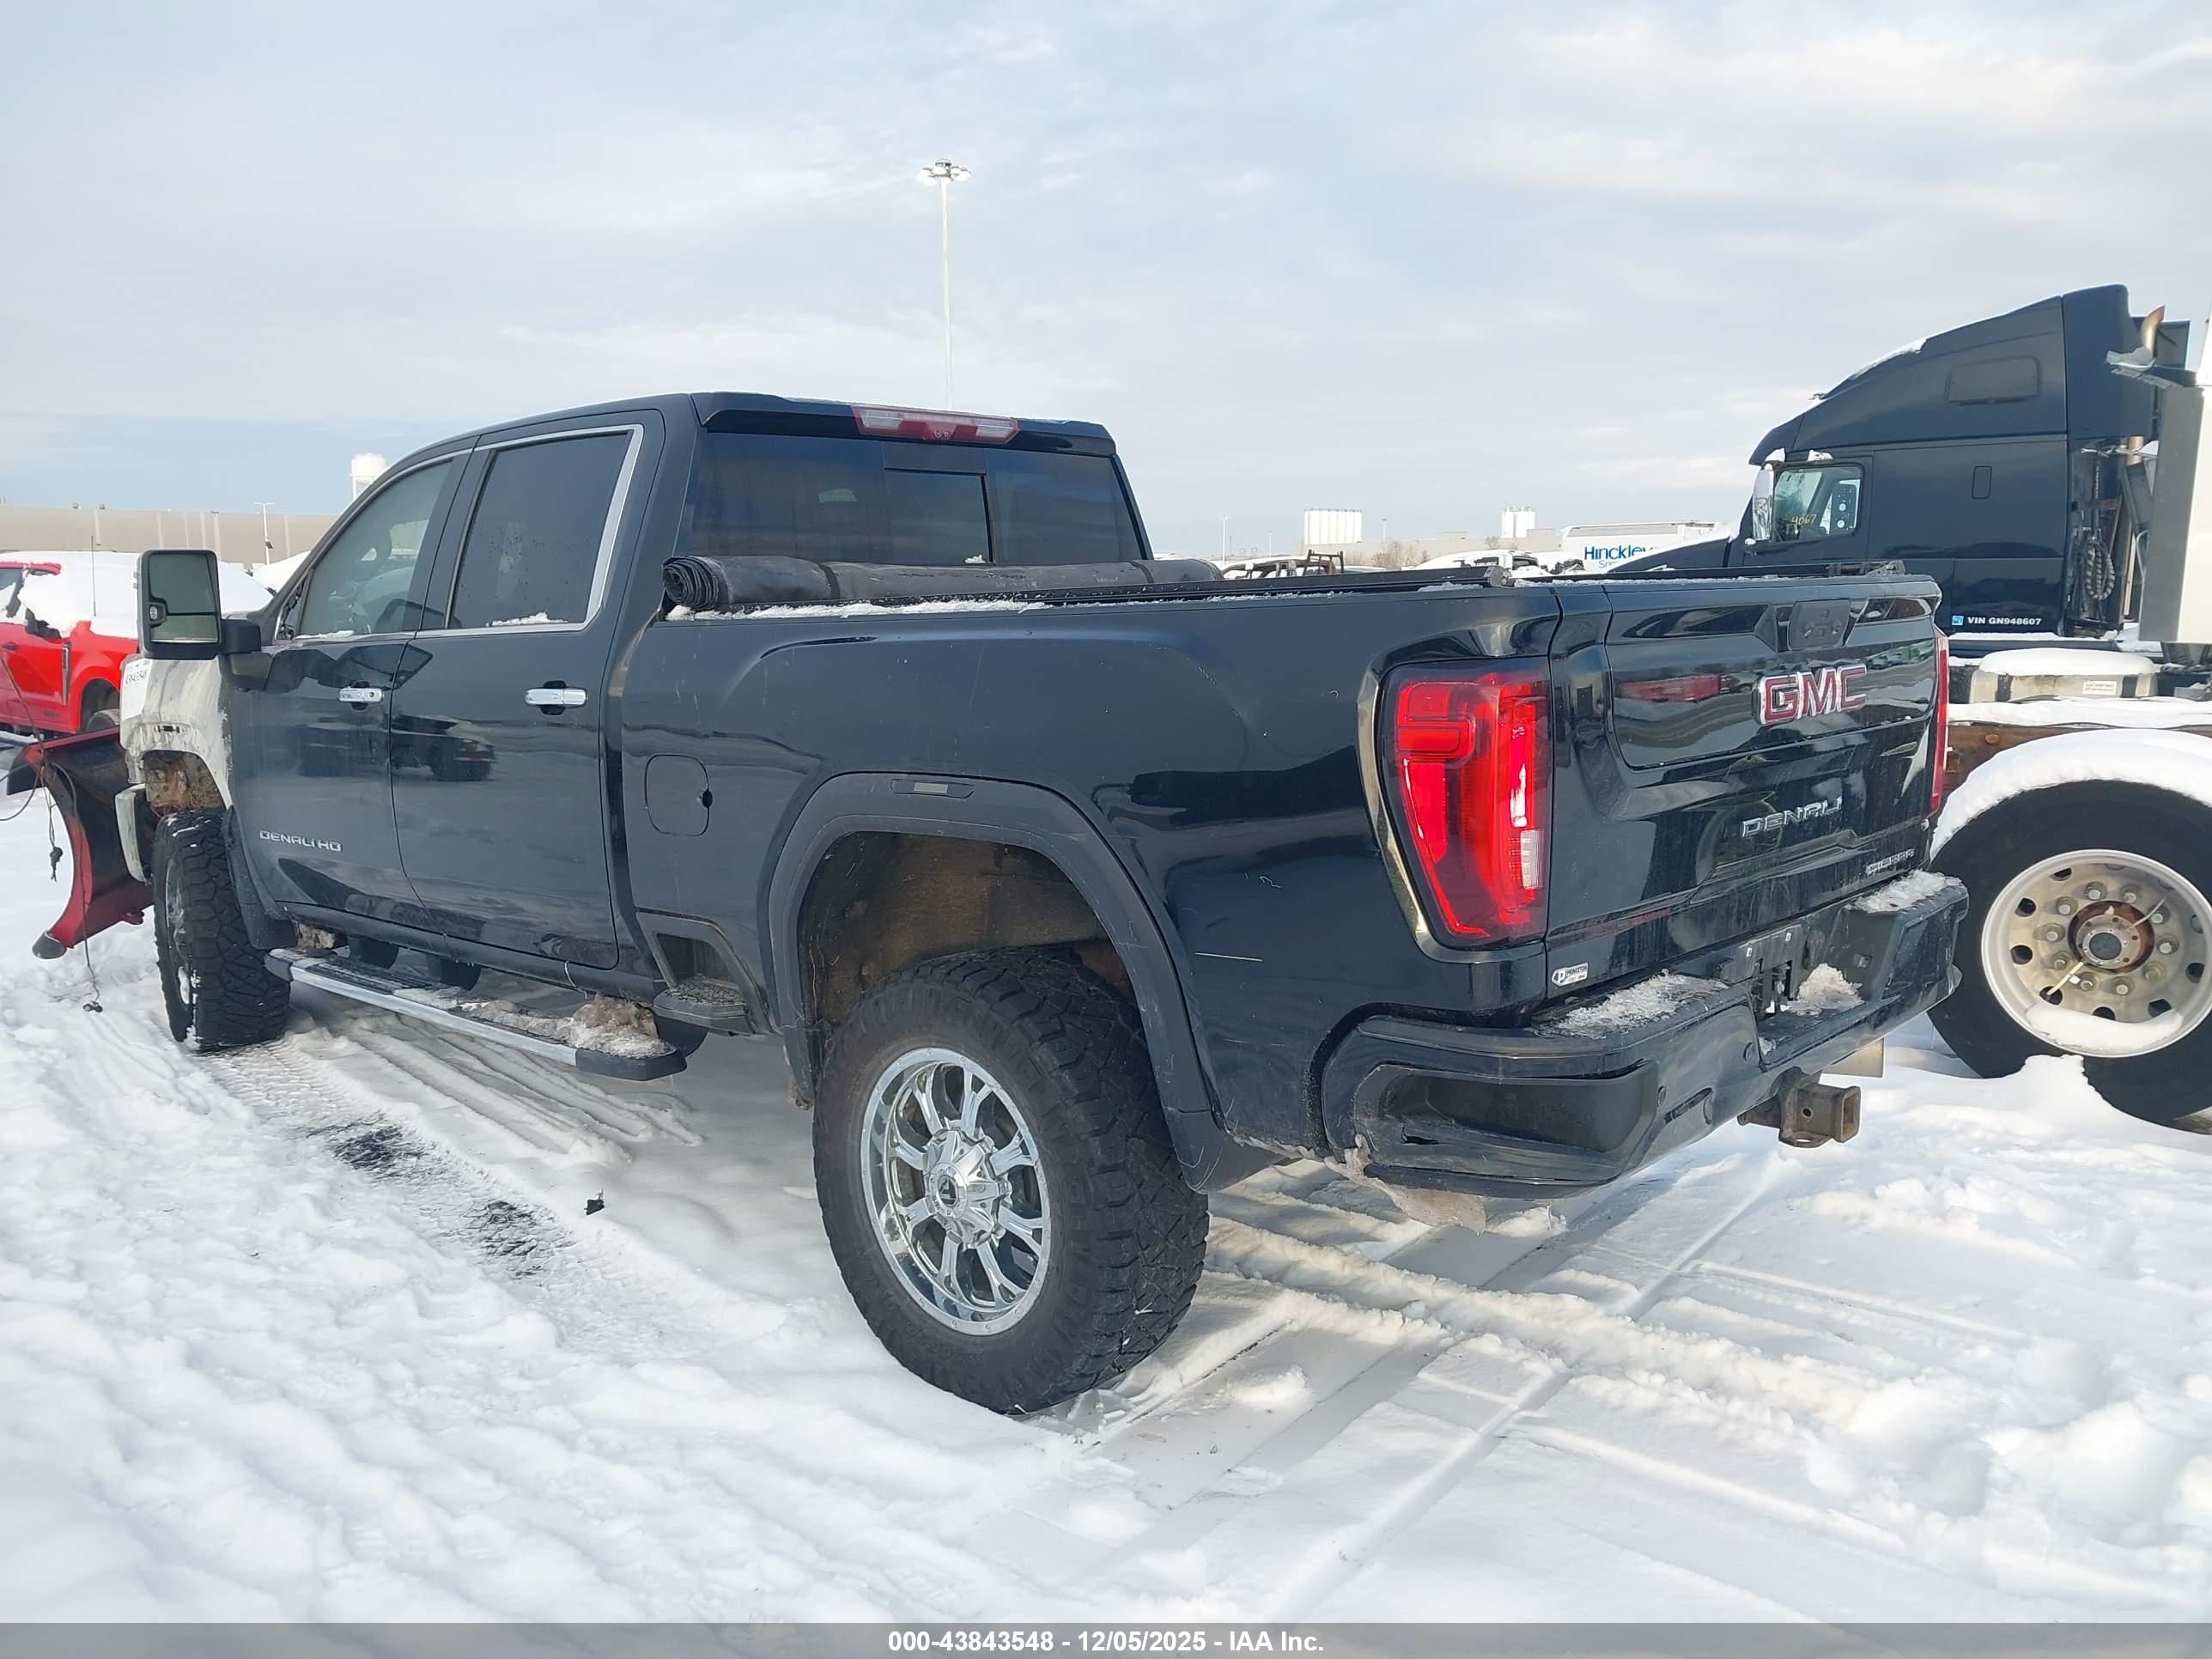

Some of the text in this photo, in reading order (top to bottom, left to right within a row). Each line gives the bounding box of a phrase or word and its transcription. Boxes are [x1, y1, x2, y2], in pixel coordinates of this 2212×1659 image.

[1757, 664, 1868, 725] GMC
[1741, 796, 1843, 837] DENALI
[259, 830, 343, 852] DENALI HD
